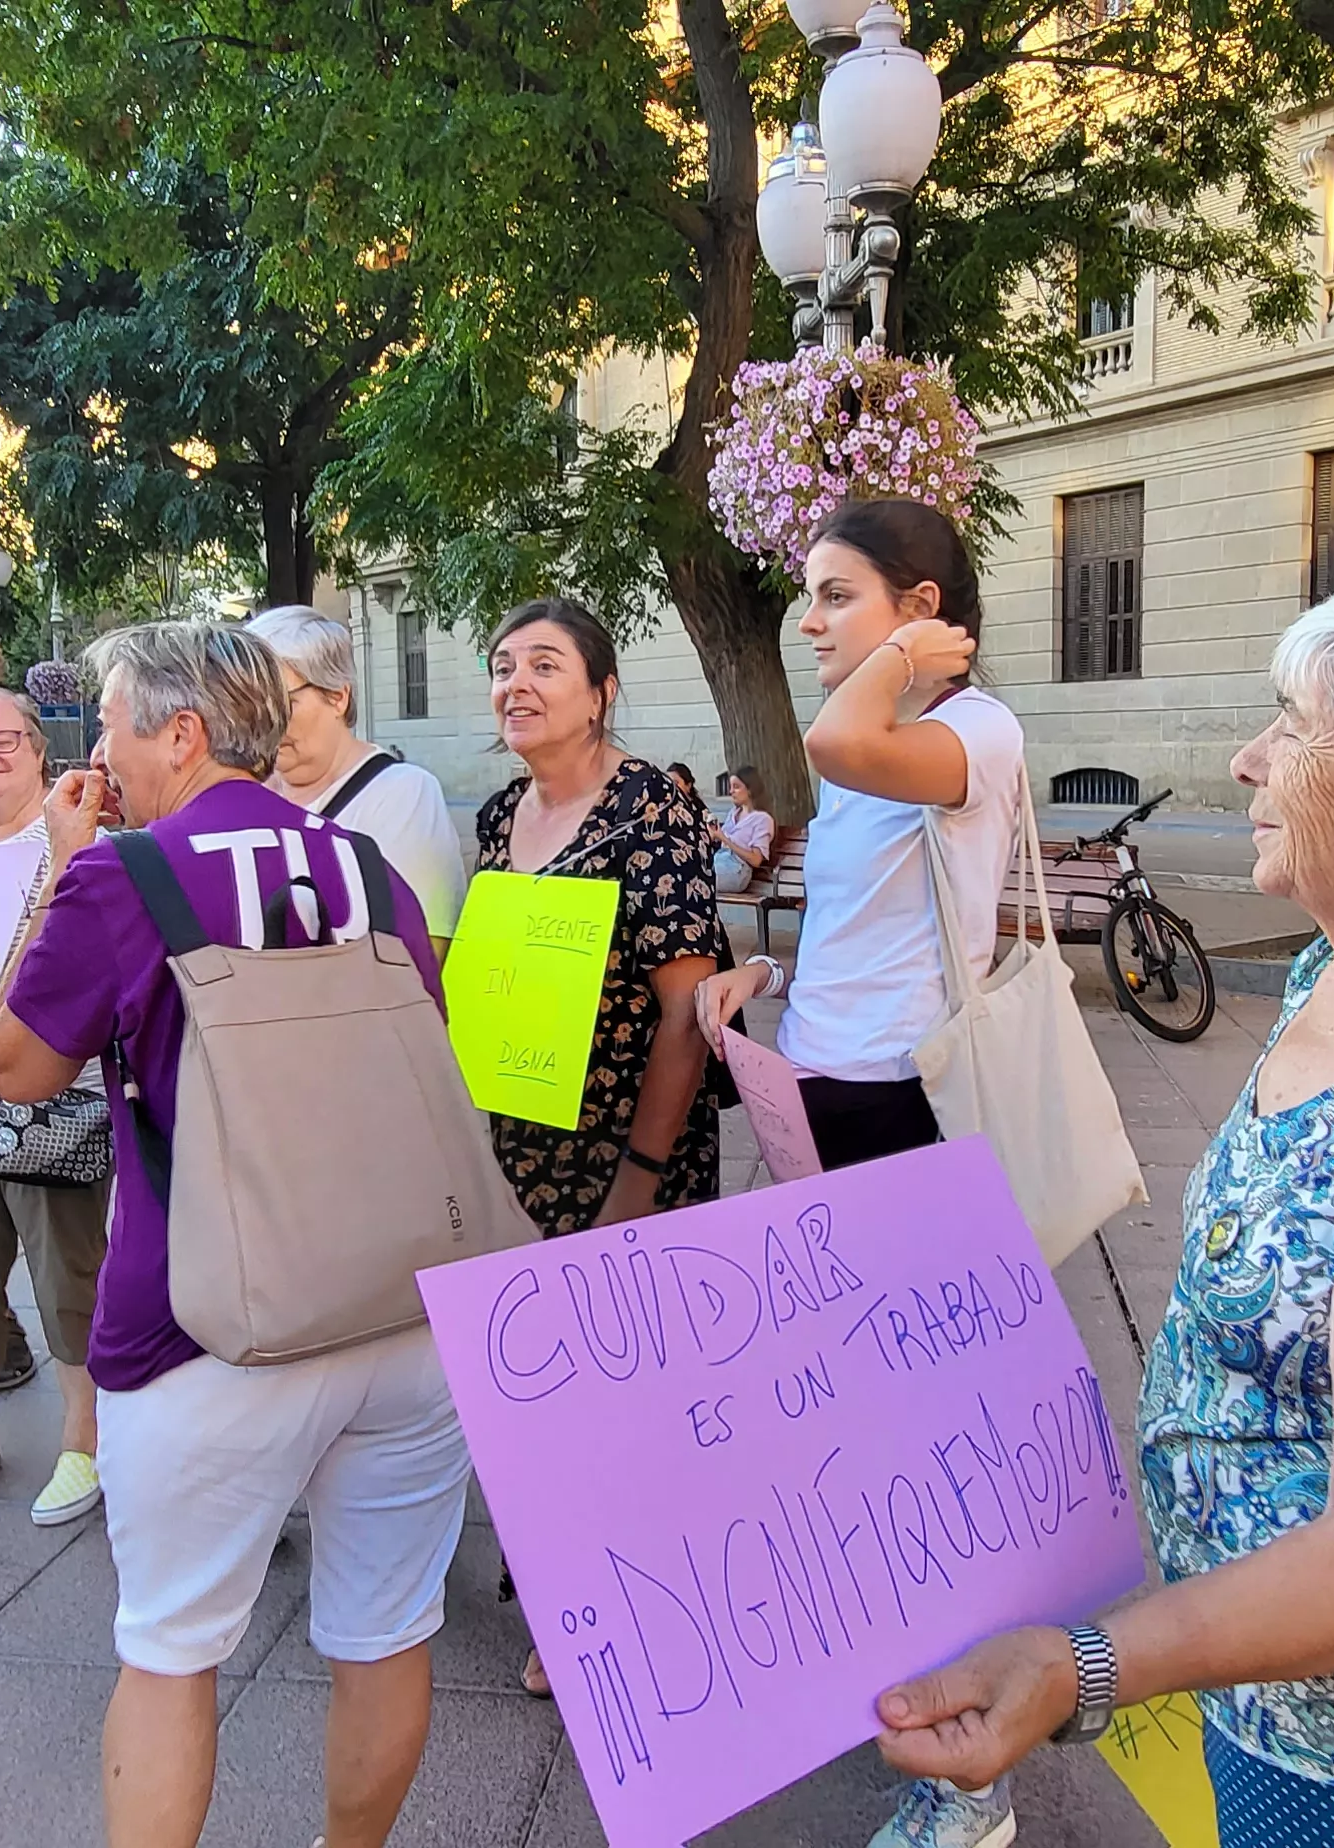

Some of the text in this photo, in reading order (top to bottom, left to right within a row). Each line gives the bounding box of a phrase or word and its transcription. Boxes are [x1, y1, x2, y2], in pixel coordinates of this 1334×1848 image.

[526, 915, 601, 943] DECENTE
[484, 967, 517, 995] IN
[498, 1040, 556, 1071] DIGNA
[686, 1254, 1042, 1448] ES UN TRABAJO
